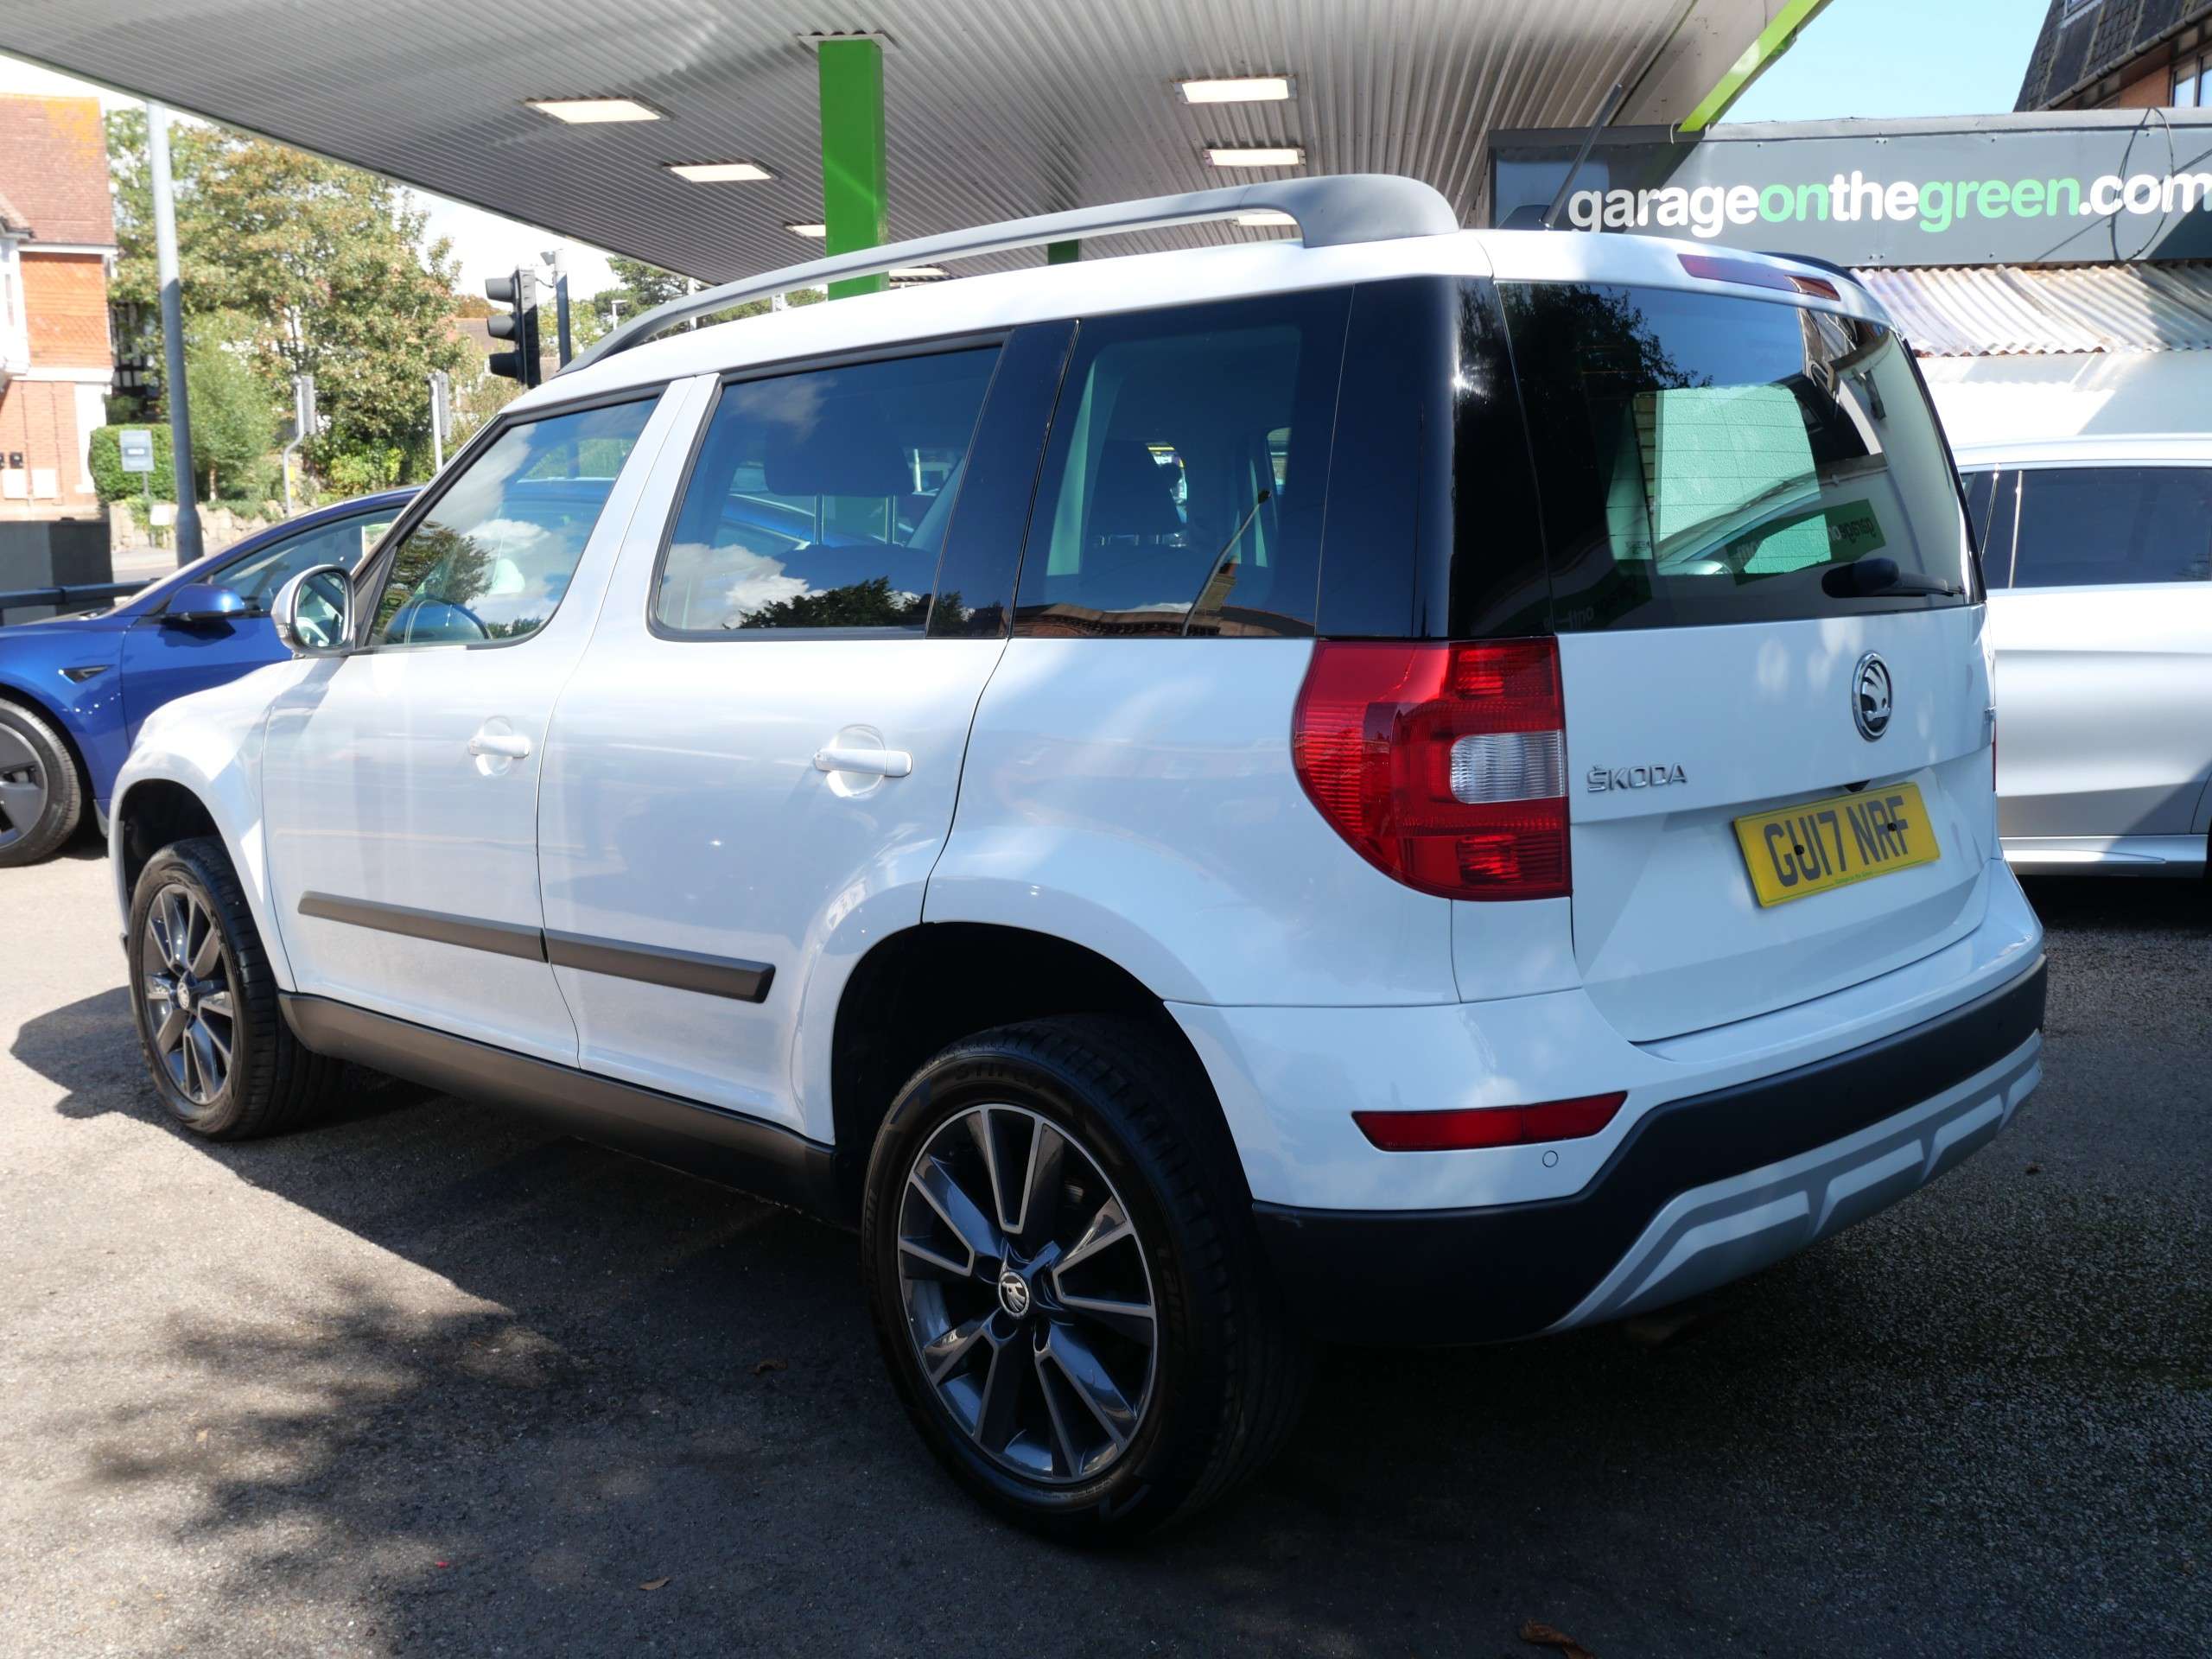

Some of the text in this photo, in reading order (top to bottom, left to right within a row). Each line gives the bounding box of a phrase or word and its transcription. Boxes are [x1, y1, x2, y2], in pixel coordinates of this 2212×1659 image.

[1568, 170, 2212, 238] garageonthegreen.com
[1586, 762, 1688, 793] ŠKODA
[1763, 794, 1910, 888] GU17 NRF
